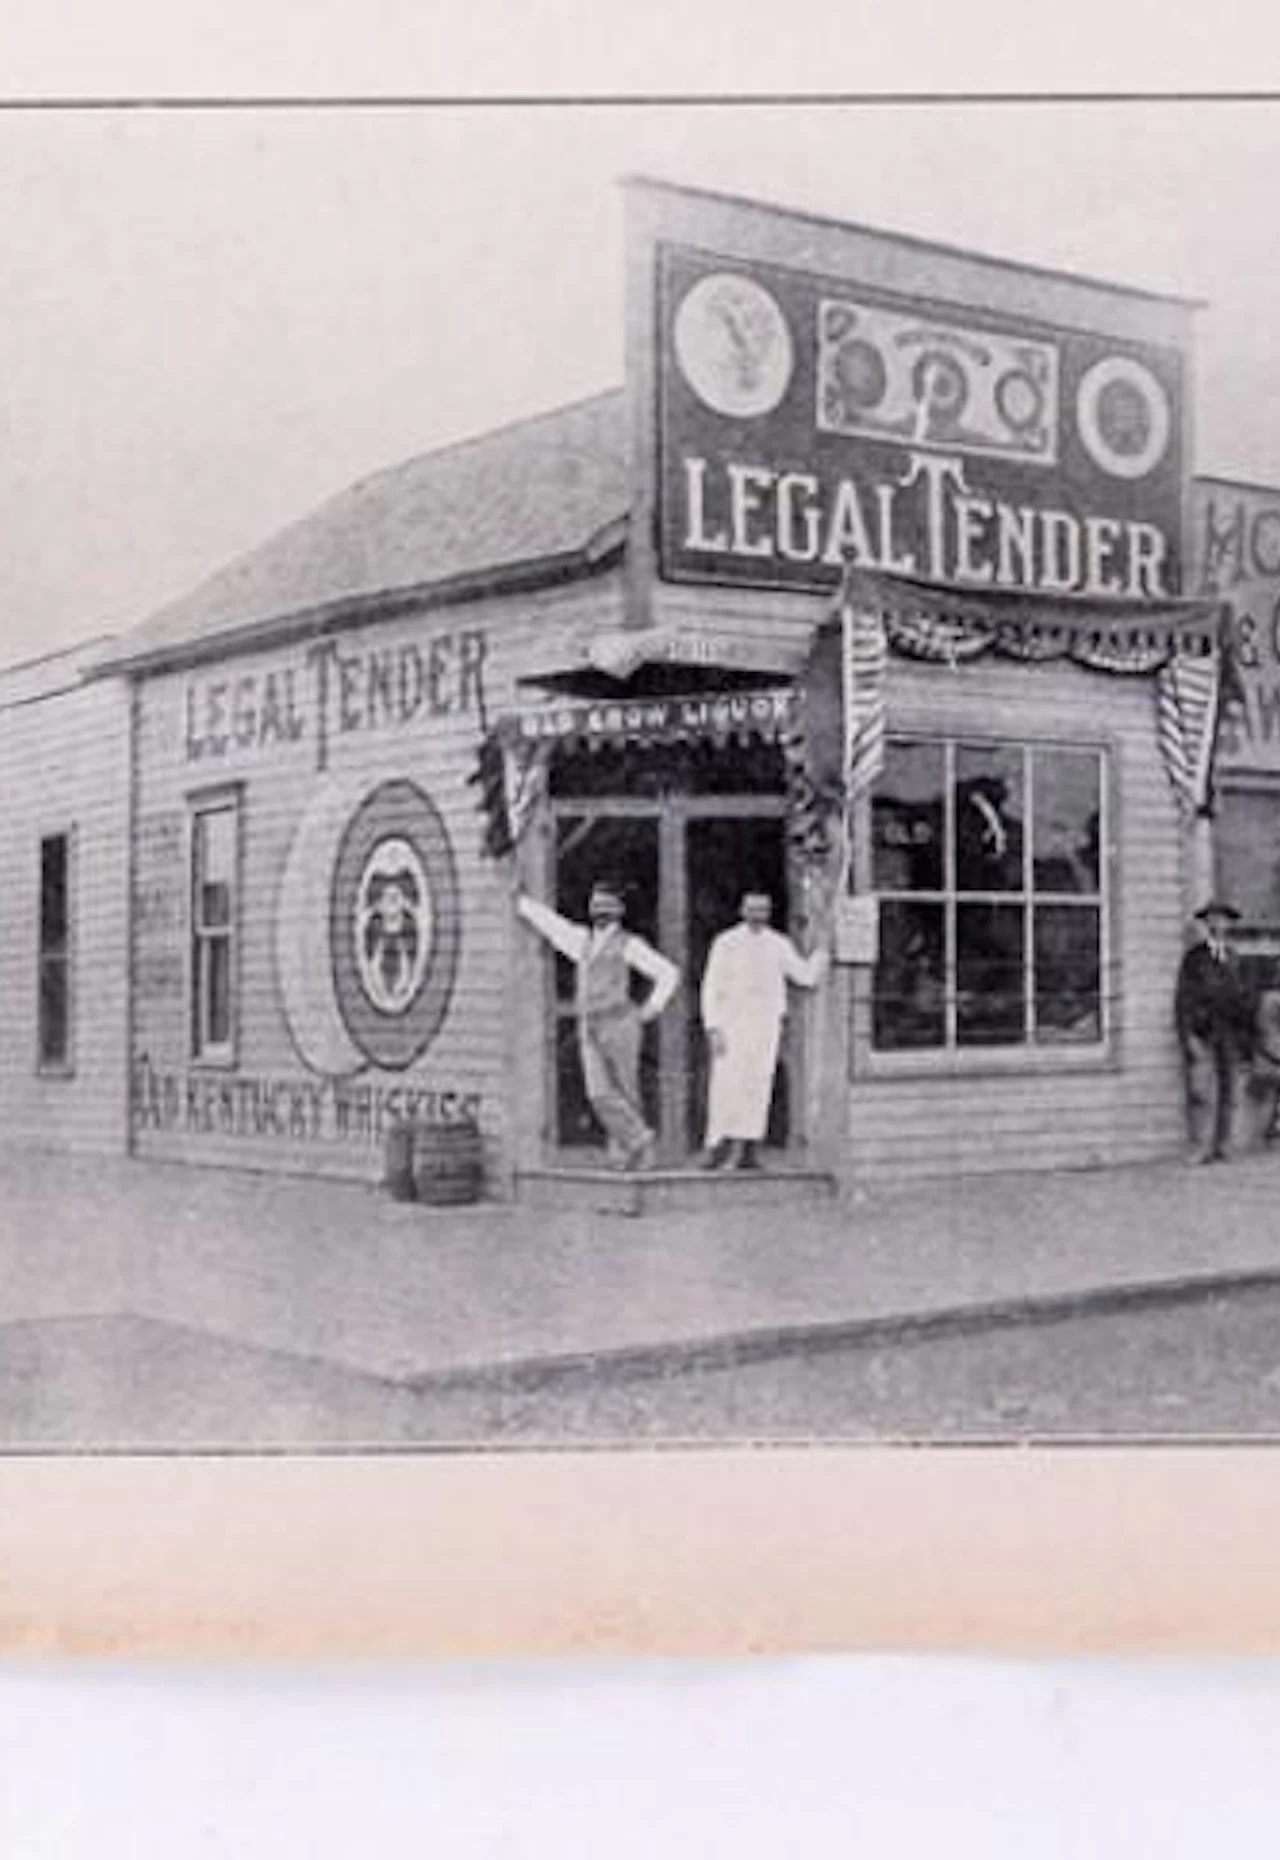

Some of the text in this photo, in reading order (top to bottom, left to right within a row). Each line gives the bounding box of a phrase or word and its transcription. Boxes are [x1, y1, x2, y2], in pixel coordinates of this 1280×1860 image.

[683, 454, 1172, 598] LEGAL TENDER
[186, 630, 493, 772] LEGAL TENDER
[1238, 614, 1260, 668] &
